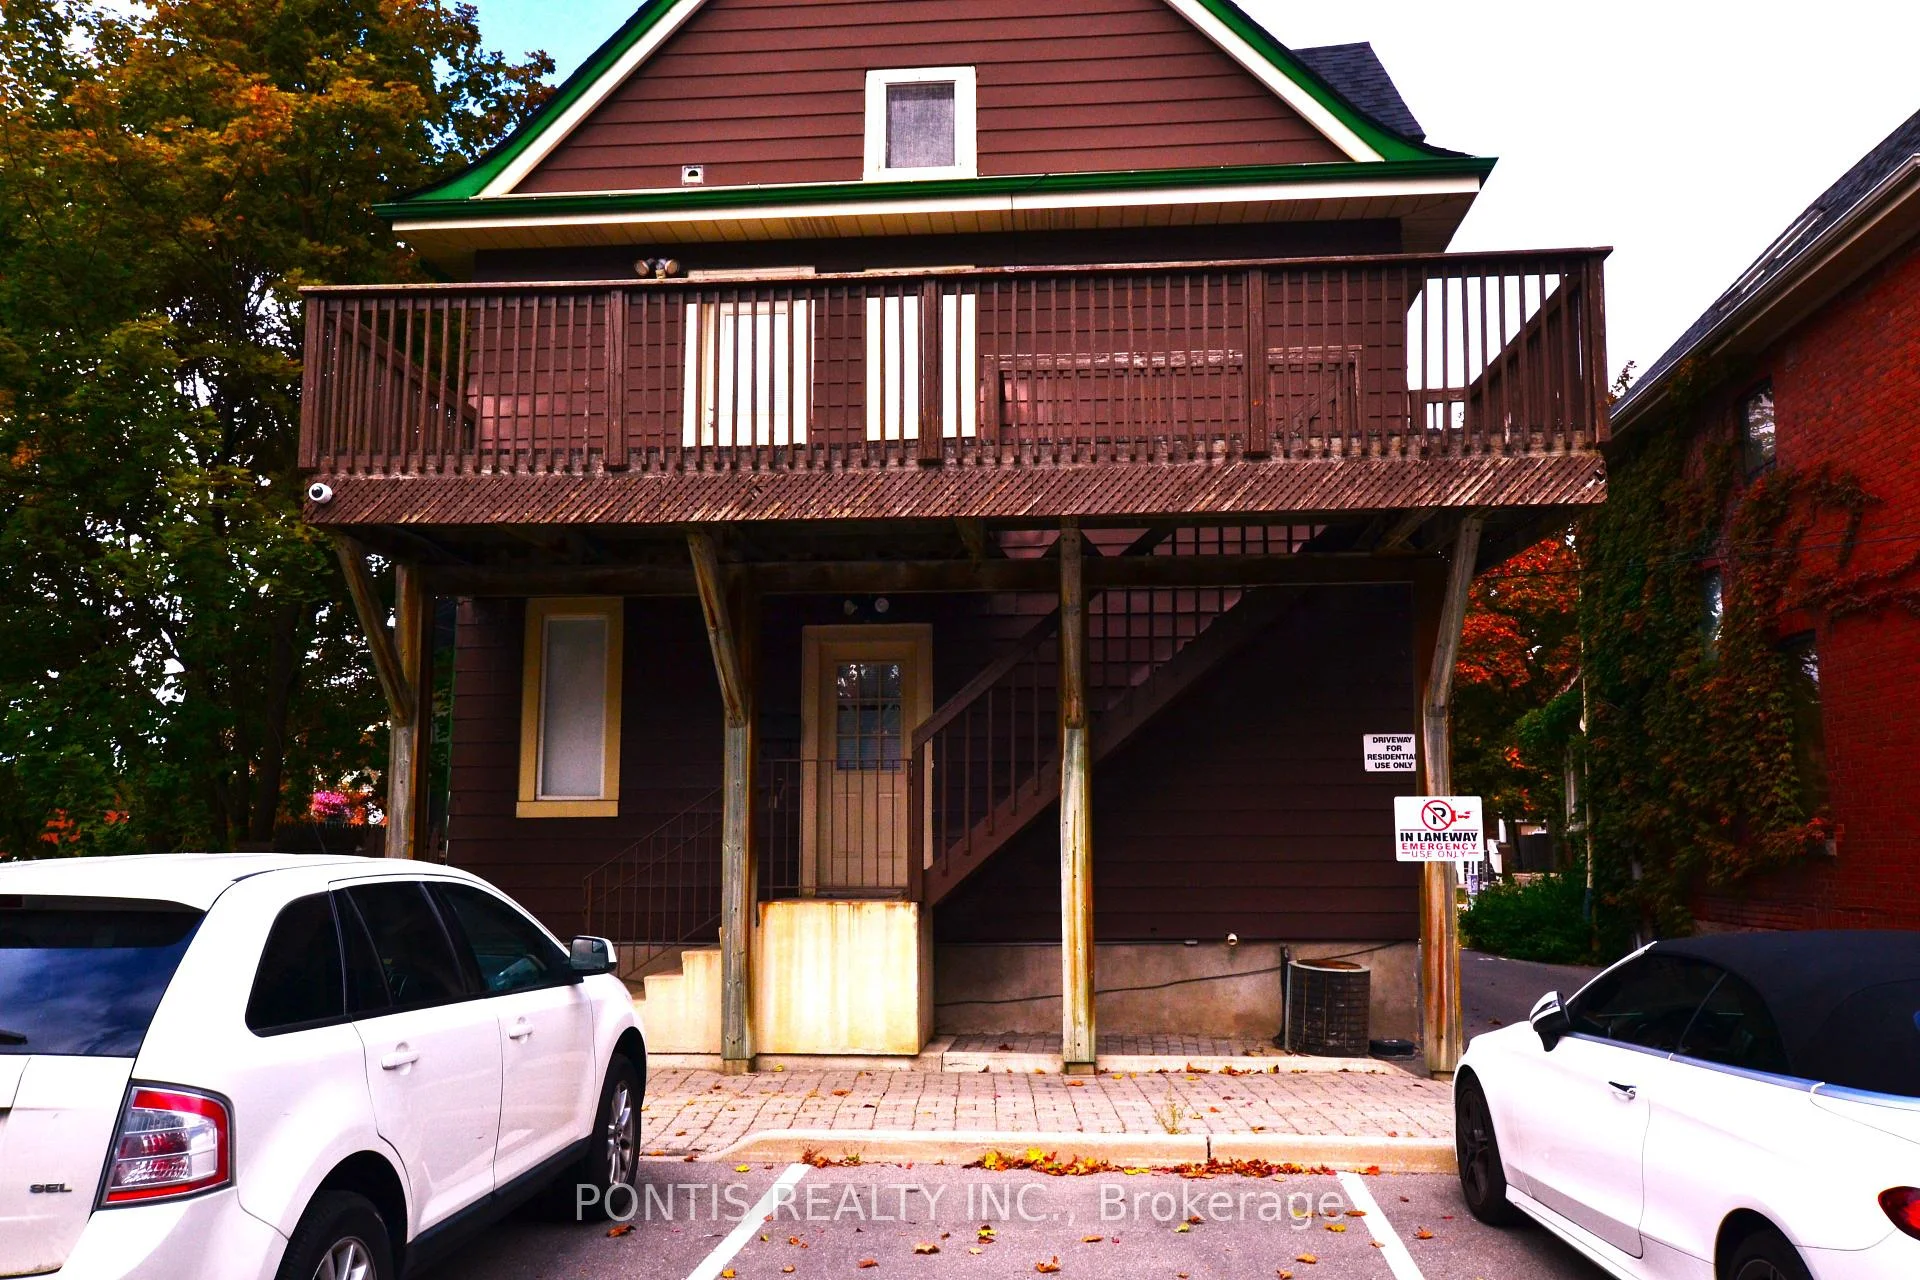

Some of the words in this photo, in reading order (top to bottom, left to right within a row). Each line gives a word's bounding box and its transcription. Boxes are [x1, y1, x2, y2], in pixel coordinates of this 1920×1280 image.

[1372, 736, 1412, 744] DRIVEWAY
[1400, 832, 1414, 842] IN
[1417, 832, 1478, 842] LANEWAY
[1411, 850, 1433, 858] USE
[1437, 850, 1466, 858] ONLY
[29, 1183, 73, 1194] SEL
